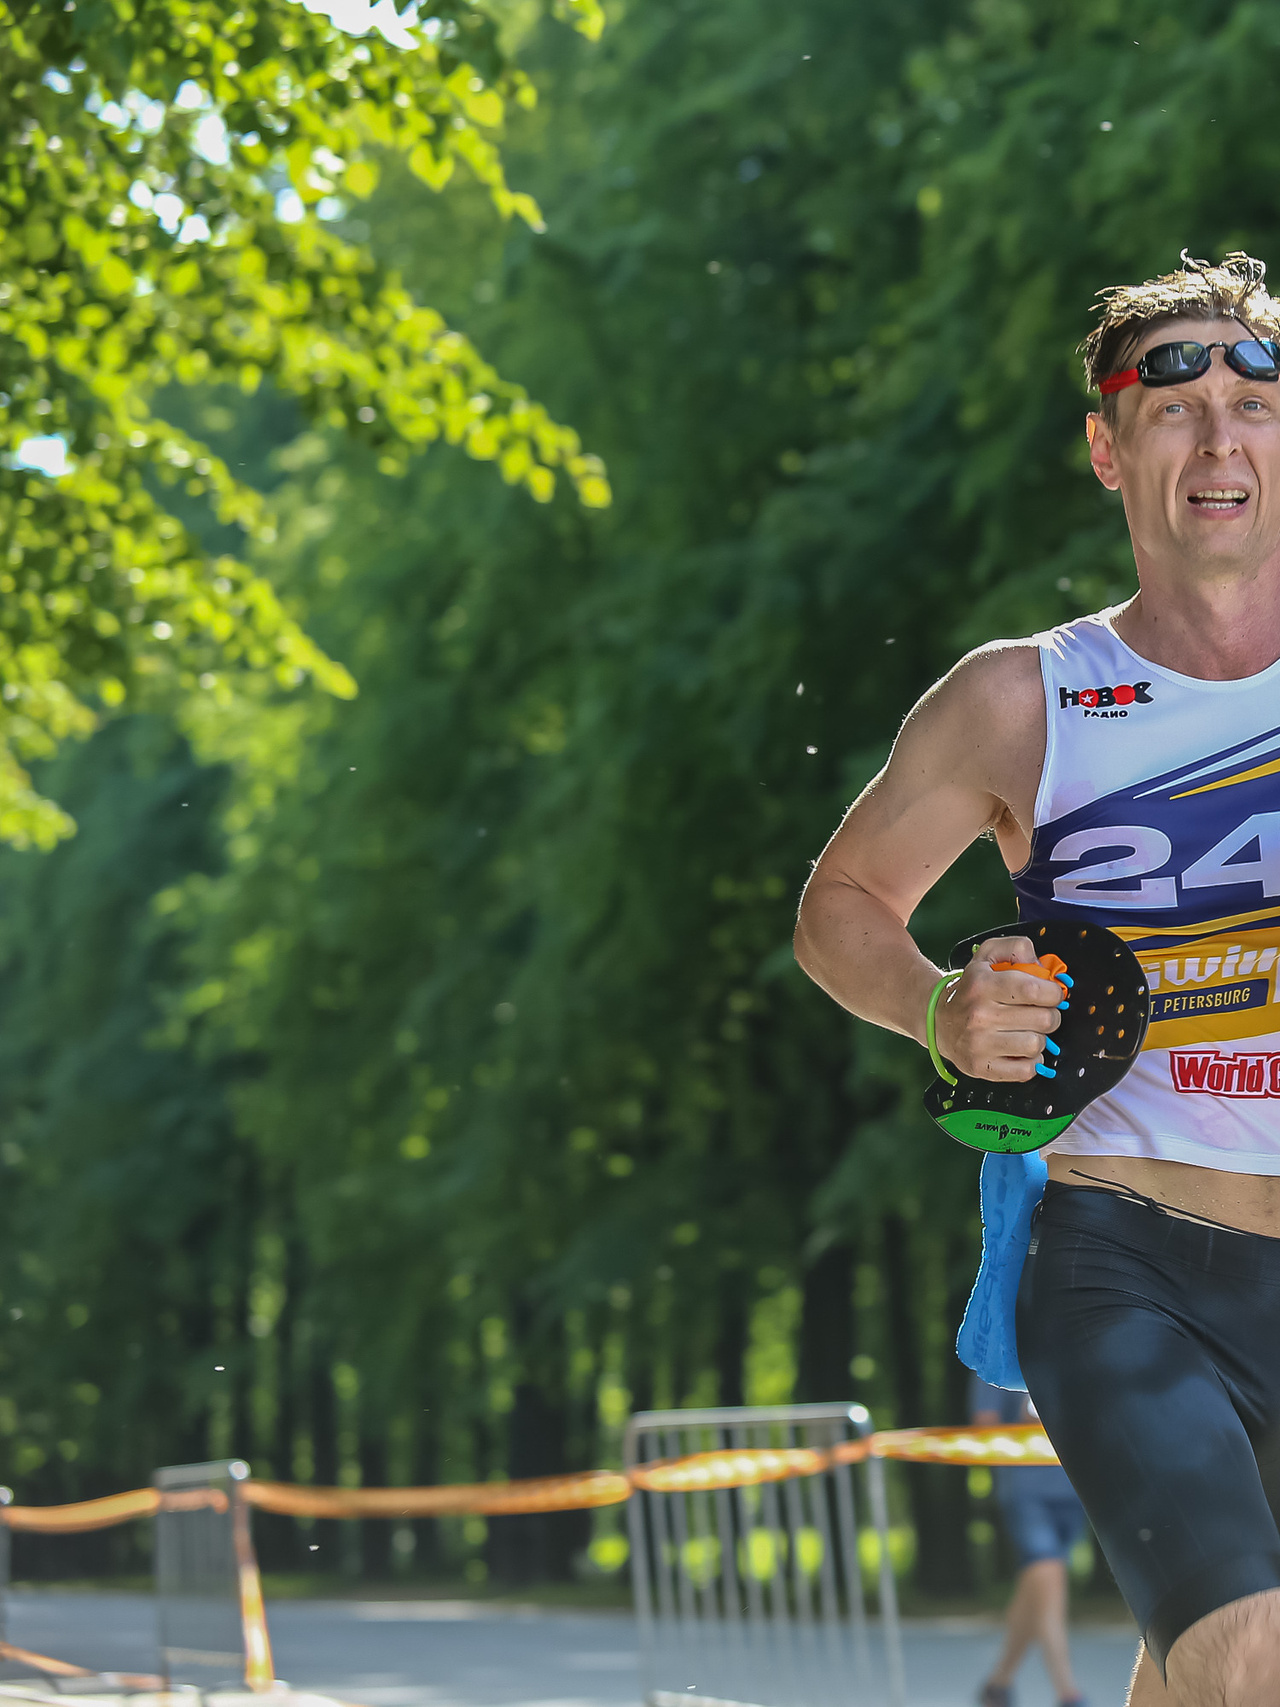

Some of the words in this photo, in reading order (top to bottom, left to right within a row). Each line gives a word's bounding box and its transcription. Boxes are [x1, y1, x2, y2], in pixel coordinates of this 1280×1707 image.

[1163, 987, 1251, 1014] PETERSBURG
[1176, 1055, 1265, 1093] World
[974, 1122, 999, 1133] WAVE
[1009, 1127, 1032, 1138] MAD
